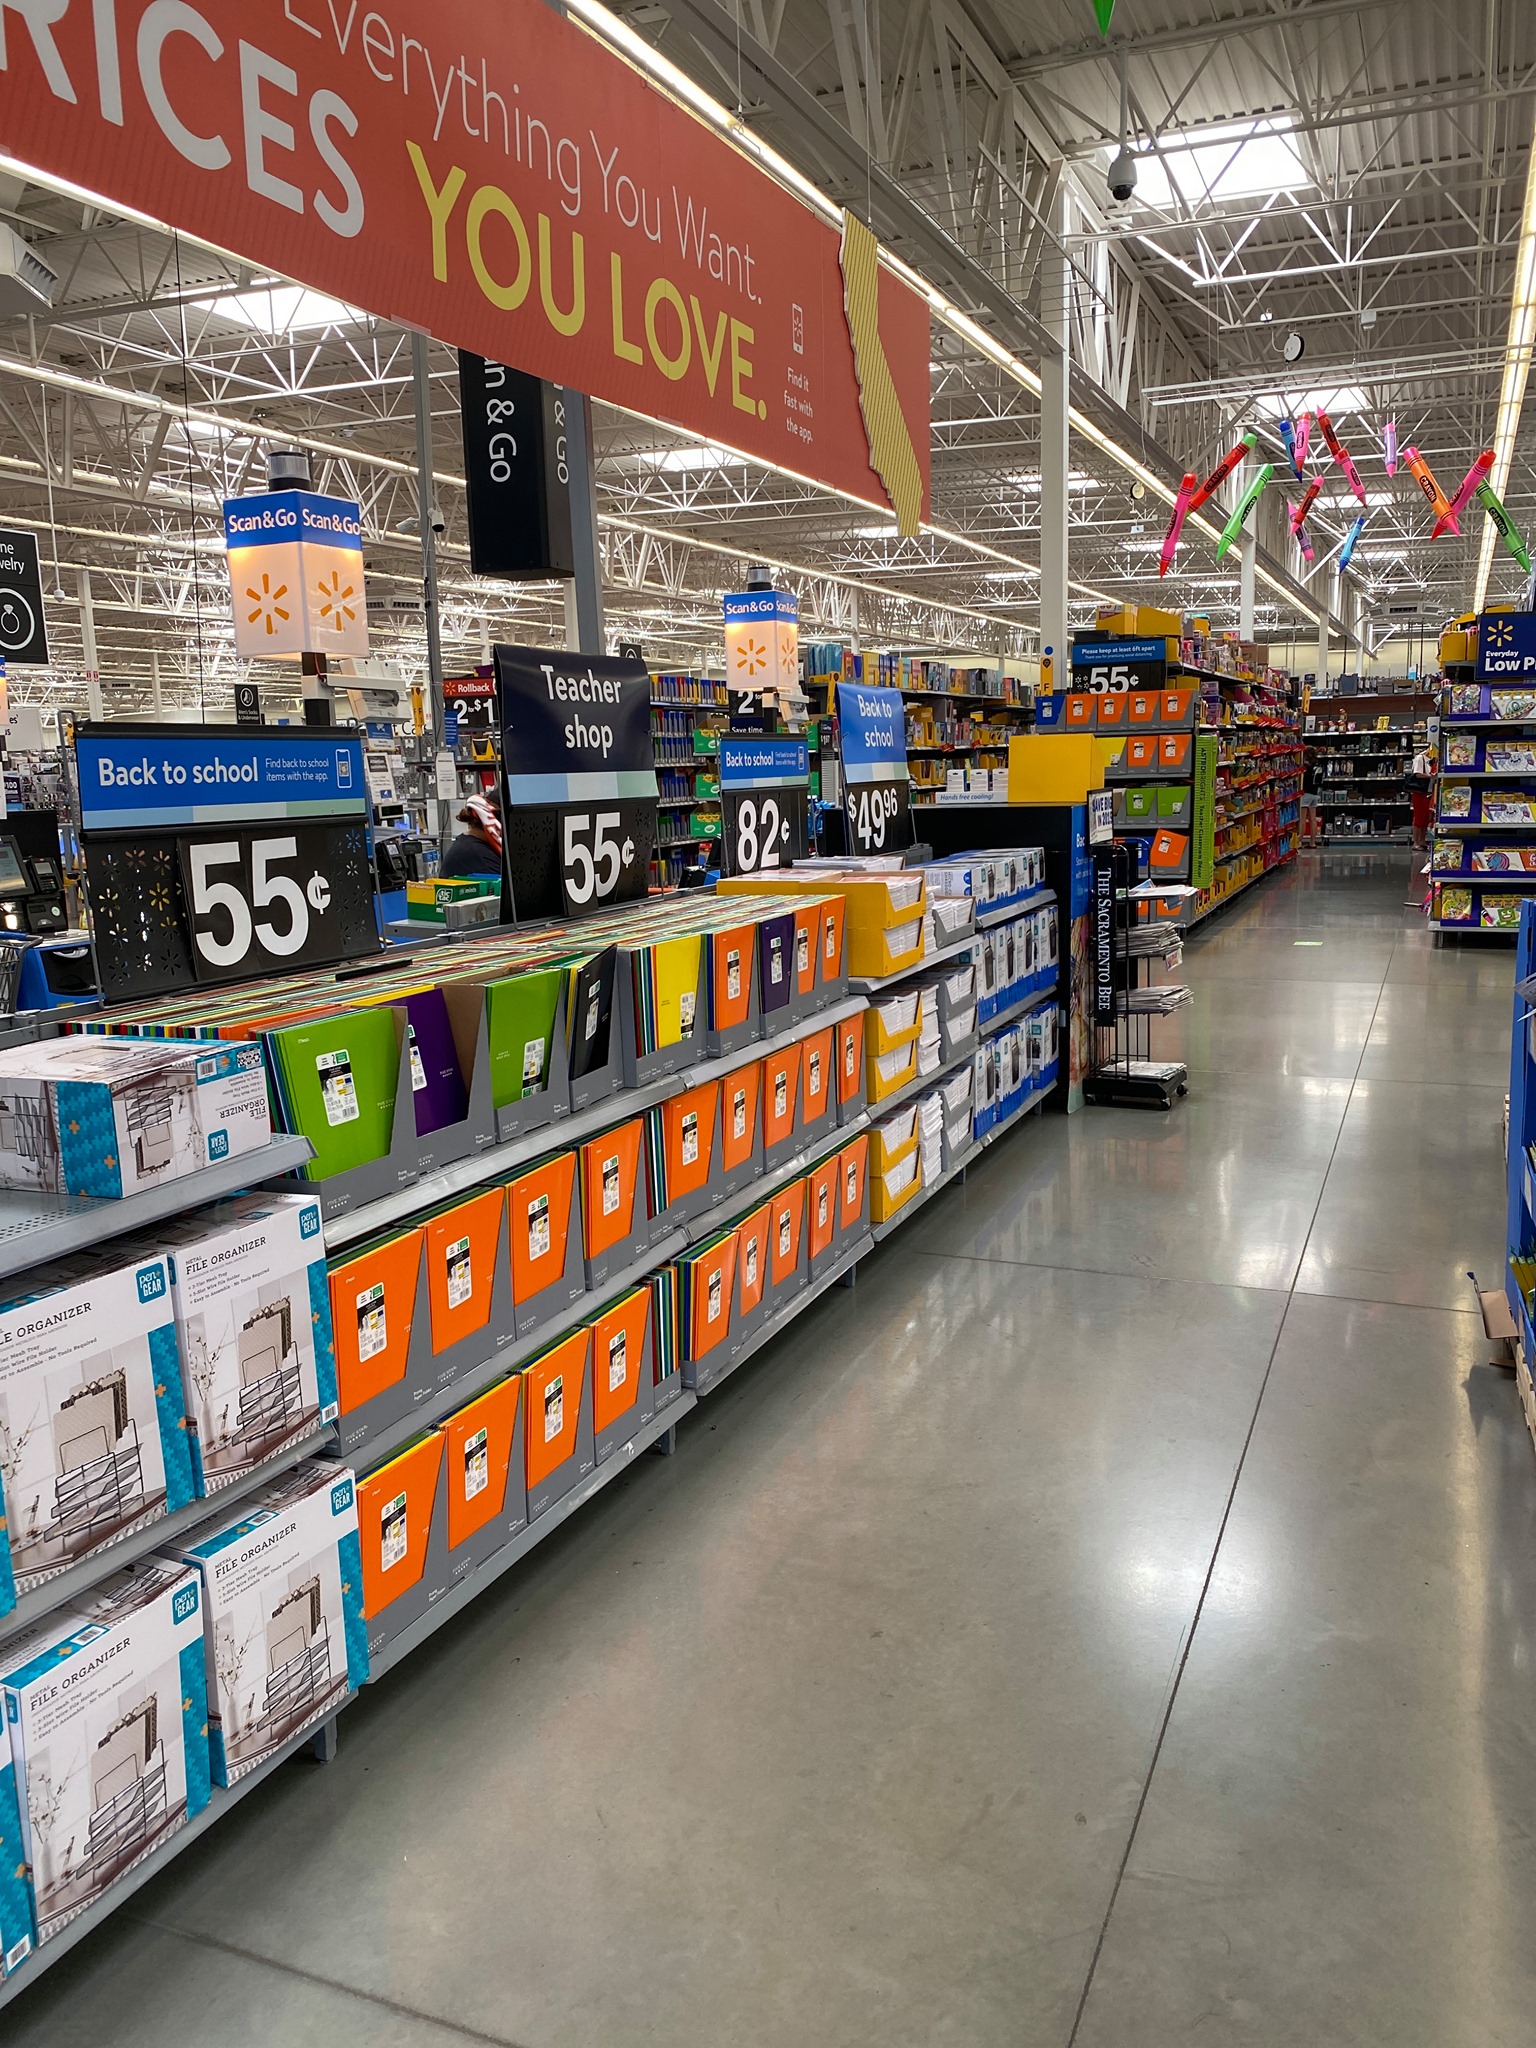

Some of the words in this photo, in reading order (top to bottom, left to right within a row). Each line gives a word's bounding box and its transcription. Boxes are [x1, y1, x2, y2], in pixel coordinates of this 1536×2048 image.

[589, 129, 661, 244] You
[672, 185, 763, 305] Want.
[405, 139, 586, 337] YOU
[610, 251, 767, 421] LOVE.
[787, 366, 803, 389] Find
[803, 375, 809, 392] it
[486, 398, 515, 425] &
[784, 389, 797, 410] fast
[798, 400, 813, 418] with
[786, 417, 798, 434] the
[799, 425, 813, 444] app.
[488, 432, 517, 483] Go
[1204, 465, 1228, 491] CRAYON
[1420, 476, 1437, 503] CRAYON
[228, 508, 297, 533] Scan&Go
[302, 508, 361, 536] Scan&Go
[1490, 508, 1508, 536] CRAYON
[726, 600, 774, 615] Scan&Go
[1484, 658, 1521, 672] Low
[1523, 656, 1536, 671] P
[1485, 650, 1519, 658] Everyday
[457, 682, 490, 693] Rollback
[540, 664, 622, 704] Teacher
[857, 694, 882, 718] Back
[881, 699, 892, 718] to
[565, 713, 614, 758] shop
[865, 725, 894, 748] school
[98, 757, 157, 787] Back
[162, 760, 187, 785] to
[192, 756, 259, 784] school
[265, 758, 280, 768] Find
[281, 757, 299, 768] back
[299, 759, 307, 768] to
[307, 757, 329, 768] school
[725, 751, 742, 767] Back
[743, 754, 752, 766] to
[753, 751, 774, 766] school
[266, 772, 285, 782] items
[286, 771, 302, 781] with
[302, 771, 314, 781] the
[314, 772, 329, 783] app.
[940, 793, 958, 801] Hands
[971, 793, 994, 801] cooling!
[1097, 867, 1111, 896] THE
[189, 836, 332, 967] 55¢
[1097, 898, 1112, 983] SACRAMENTO
[1098, 985, 1112, 1011] BEE
[219, 1098, 266, 1119] ORGANIZER
[250, 1106, 266, 1118] FILE
[303, 1218, 318, 1234] GEAR
[185, 1260, 208, 1275] FILE
[211, 1236, 266, 1265] ORGANIZER
[185, 1255, 202, 1265] METAL
[142, 1278, 162, 1297] GEAR
[16, 1302, 92, 1338] ORGANIZER
[10, 1351, 26, 1360] Mesh
[26, 1345, 40, 1354] Tray
[11, 1359, 26, 1368] Wire
[26, 1353, 38, 1362] File
[38, 1346, 57, 1357] Holder
[16, 1360, 43, 1374] Assemble
[57, 1348, 73, 1358] Tools
[73, 1337, 97, 1351] Required
[335, 1493, 351, 1511] GEAR
[215, 1559, 238, 1579] FILE
[241, 1522, 297, 1563] ORGANIZER
[177, 1596, 195, 1618] GEAR
[30, 1686, 59, 1711] FILE
[62, 1637, 131, 1690] ORGANIZER
